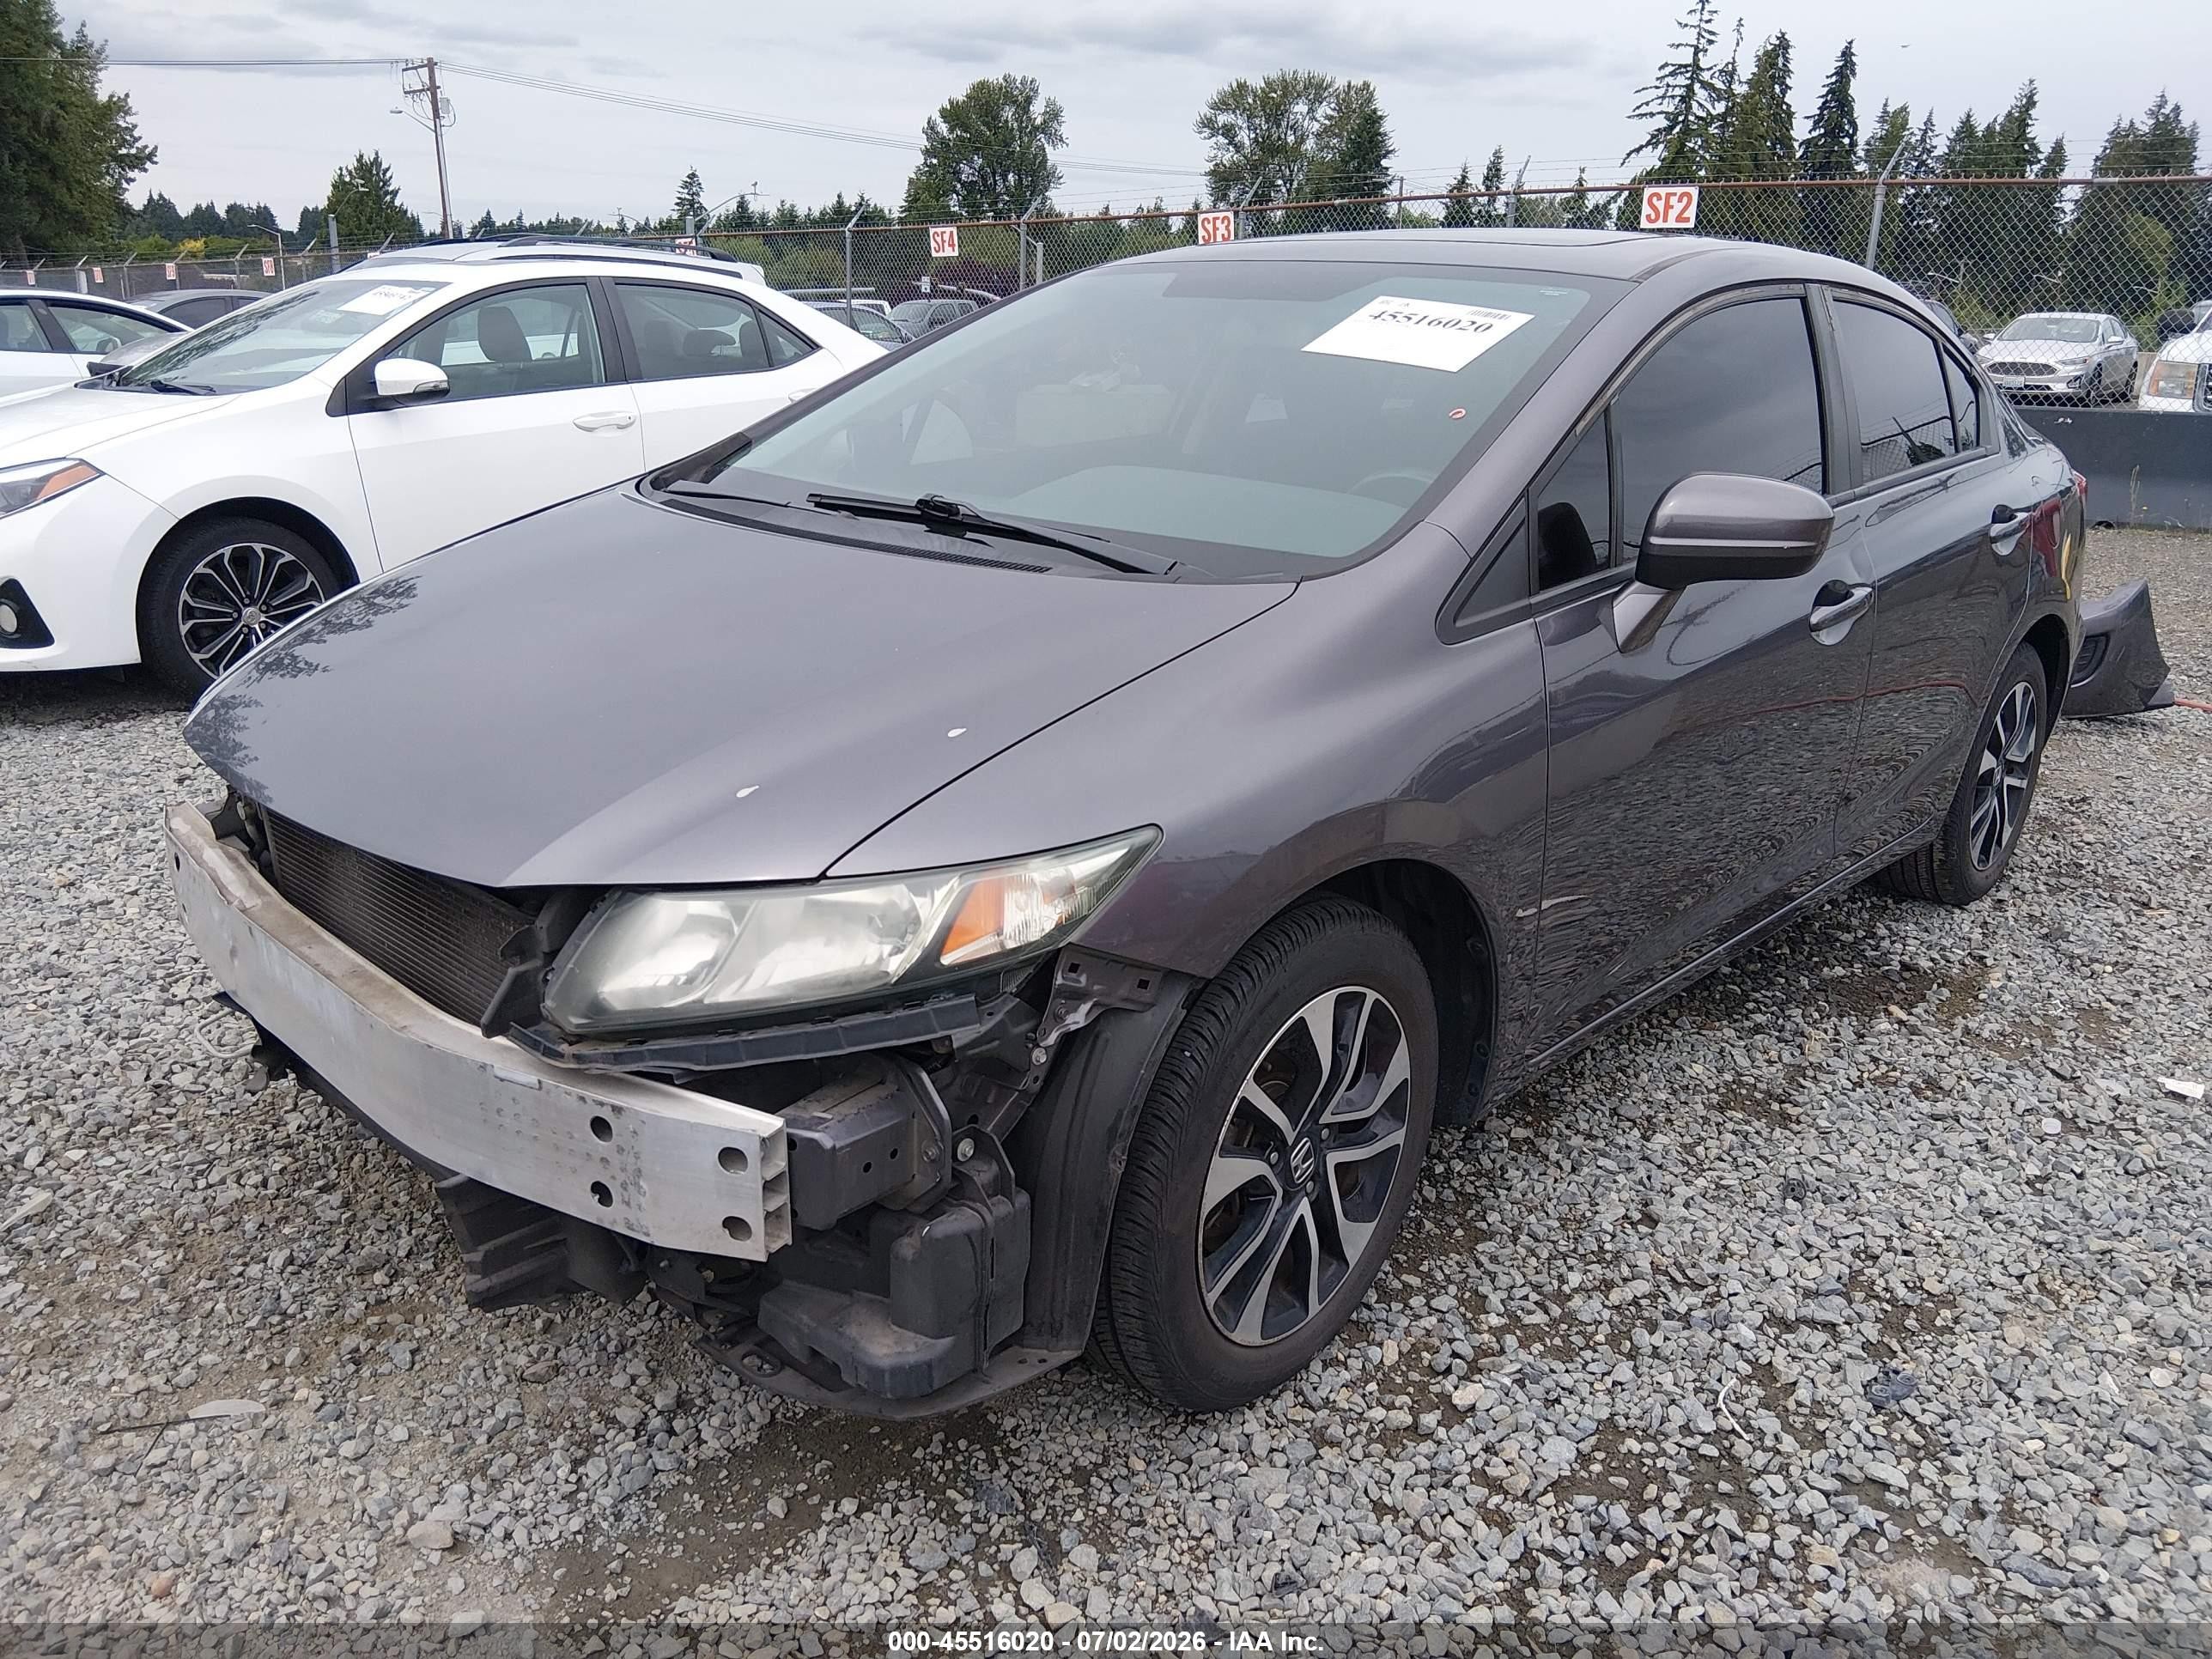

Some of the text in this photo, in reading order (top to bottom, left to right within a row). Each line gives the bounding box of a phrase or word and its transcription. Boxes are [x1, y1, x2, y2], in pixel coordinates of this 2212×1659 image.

[1645, 191, 1693, 224] SF2
[932, 230, 956, 253] SF4
[1201, 216, 1231, 244] SF3
[1369, 310, 1494, 333] 45516020
